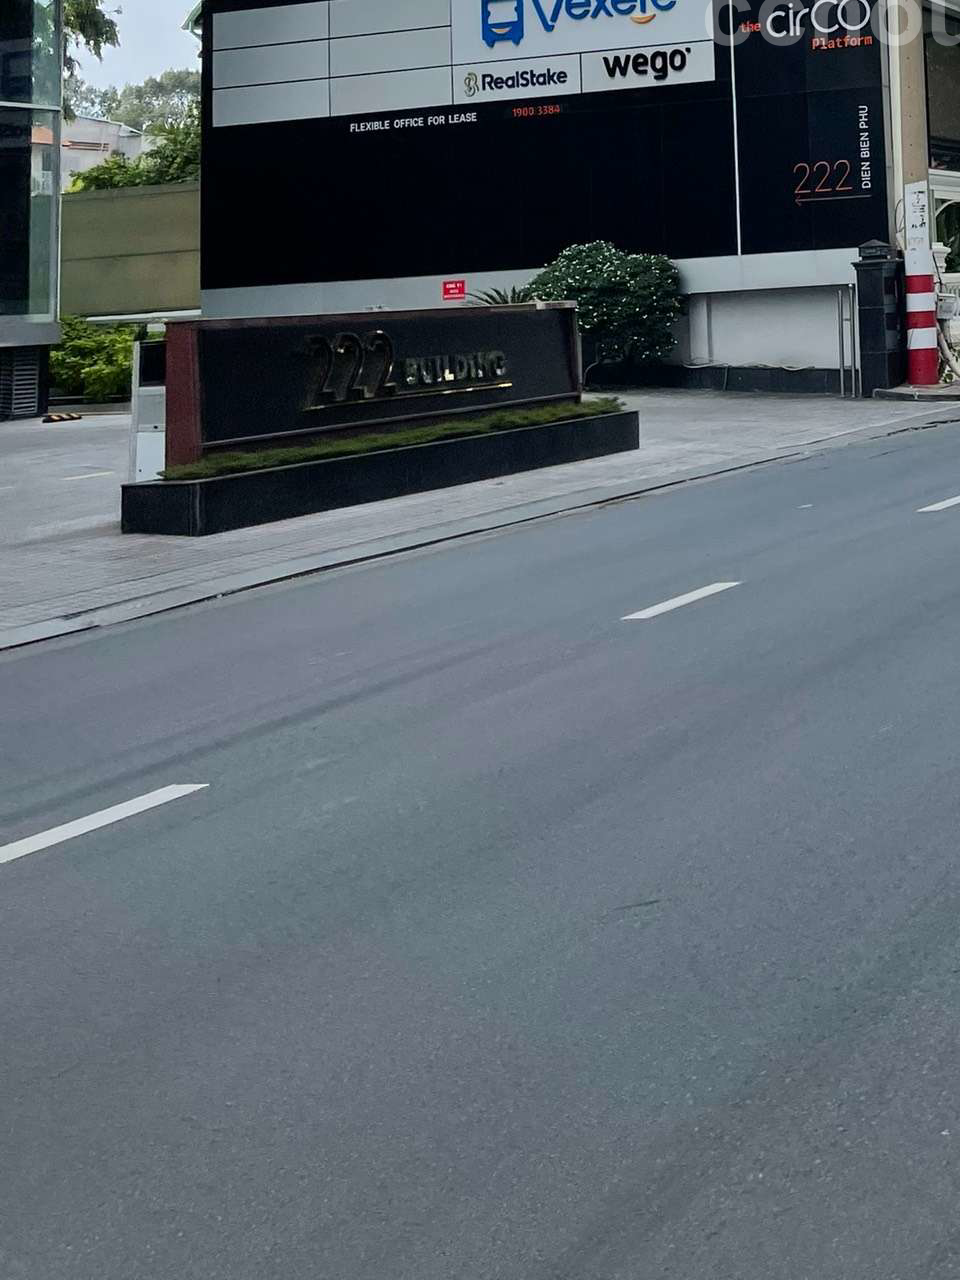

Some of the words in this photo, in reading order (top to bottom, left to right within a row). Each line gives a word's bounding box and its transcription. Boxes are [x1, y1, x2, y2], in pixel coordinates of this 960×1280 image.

[740, 20, 762, 33] the
[811, 35, 873, 51] Platform
[481, 68, 569, 91] RealStake
[350, 120, 390, 133] FLEXIBLE
[393, 117, 424, 129] OFFICE
[427, 115, 446, 126] FOR
[449, 112, 477, 124] LEASE
[512, 106, 535, 118] 1900
[858, 104, 869, 129] PHU
[859, 132, 871, 158] BIEN
[793, 159, 853, 194] 222
[861, 161, 872, 189] DIEN
[303, 330, 398, 410] 222
[403, 349, 506, 385] BUILDING
